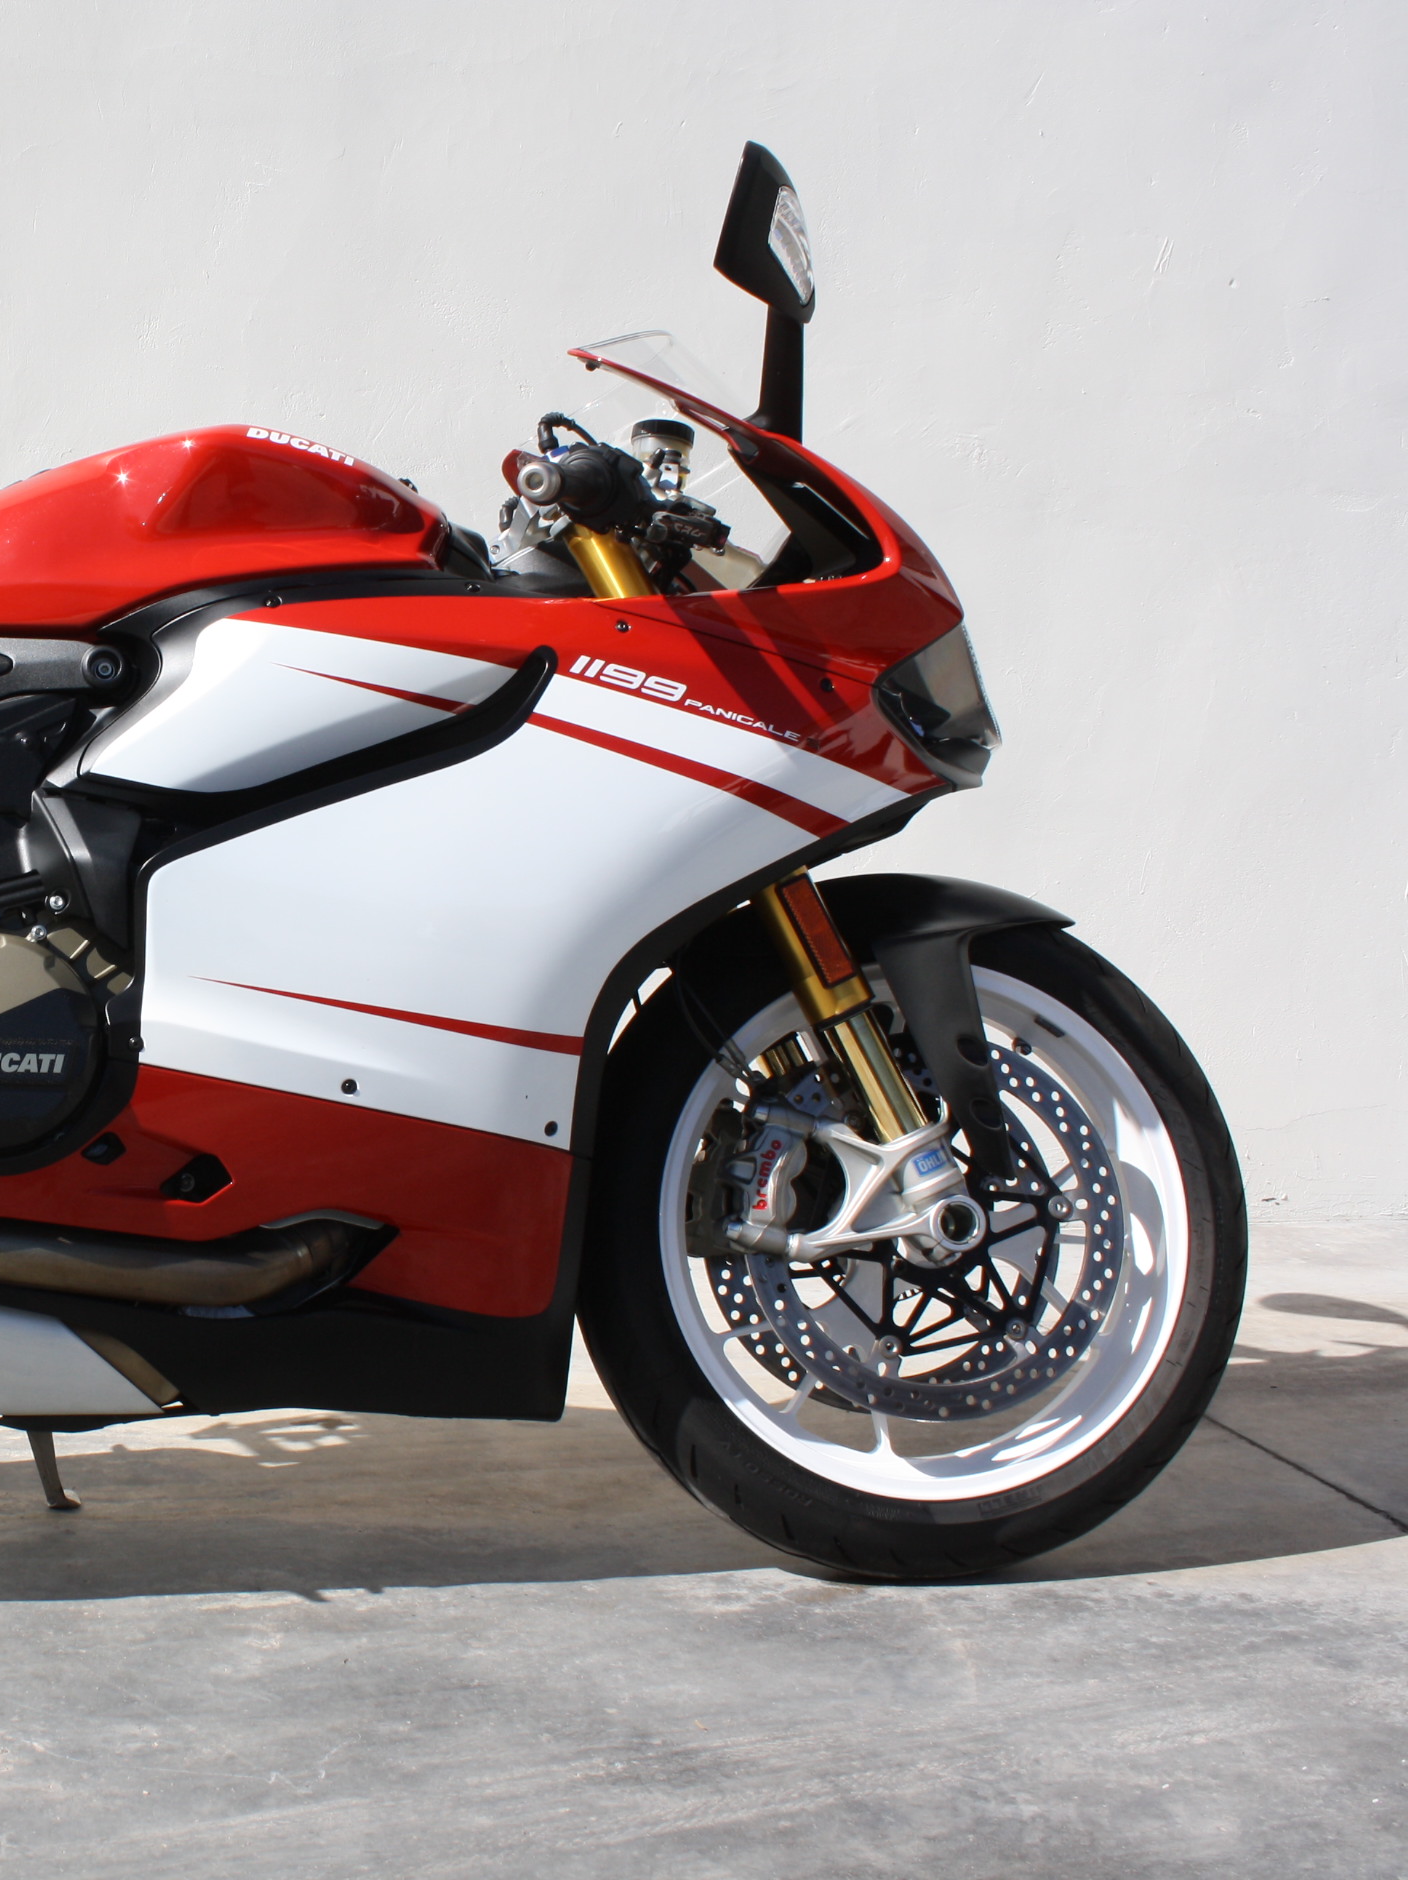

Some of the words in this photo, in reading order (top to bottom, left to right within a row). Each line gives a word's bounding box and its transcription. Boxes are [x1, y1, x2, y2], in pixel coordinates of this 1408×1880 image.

[246, 427, 355, 467] DUCATI
[569, 654, 687, 702] 1199
[752, 1140, 782, 1210] brembo
